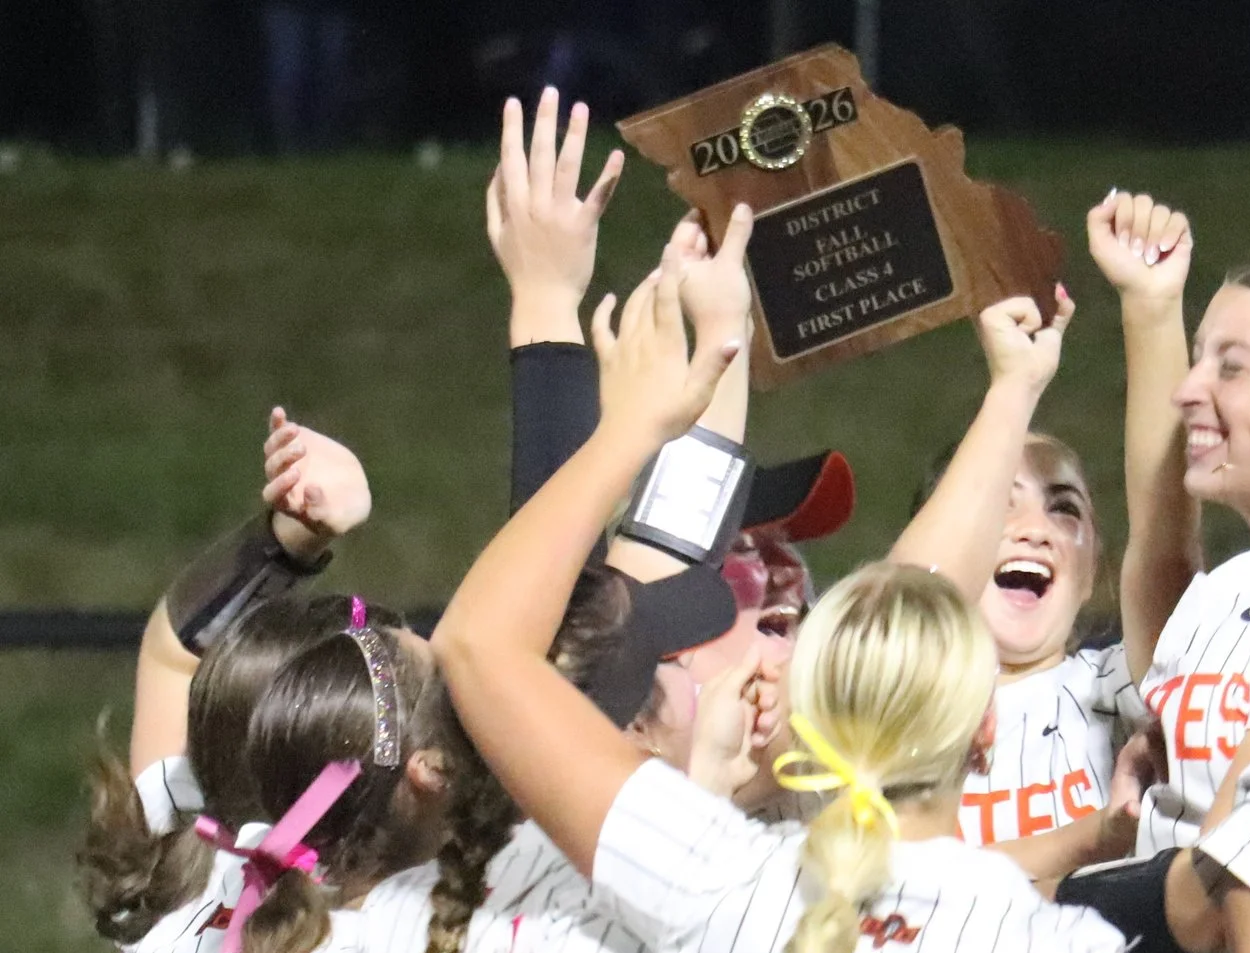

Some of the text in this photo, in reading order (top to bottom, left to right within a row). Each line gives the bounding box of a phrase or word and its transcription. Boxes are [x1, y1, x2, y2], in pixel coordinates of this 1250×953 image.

[694, 133, 739, 175] 20
[808, 89, 854, 132] 26
[785, 188, 881, 237] DISTRICT
[815, 224, 869, 254] FALL
[793, 231, 899, 282] SOFTBALL
[814, 260, 894, 302] CLASS 4
[796, 277, 927, 339] FIRST PLACE
[1144, 672, 1250, 761] TES
[956, 768, 1099, 846] TES
